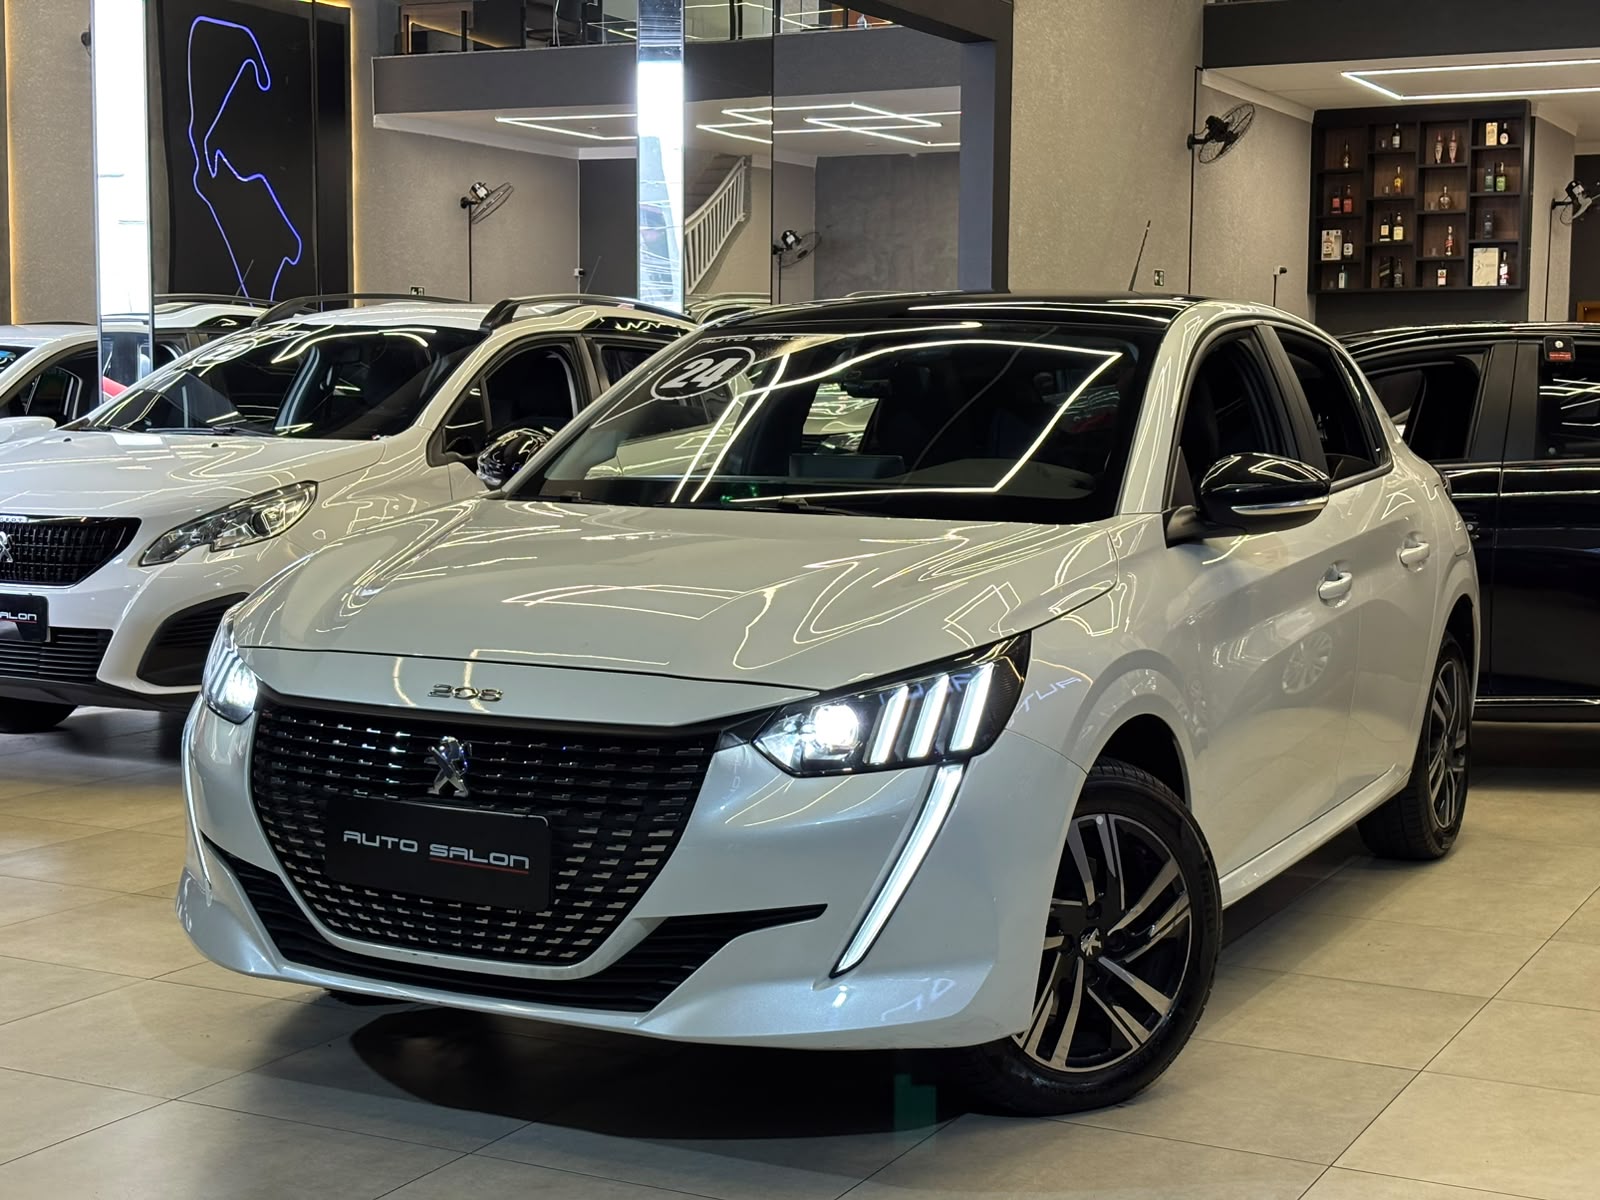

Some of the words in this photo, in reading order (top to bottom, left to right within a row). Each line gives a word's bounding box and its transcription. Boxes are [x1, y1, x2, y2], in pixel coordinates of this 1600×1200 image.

[699, 336, 748, 344] AUTO
[659, 357, 744, 389] 24
[0, 611, 38, 621] ALON
[427, 683, 504, 702] 208
[343, 830, 418, 853] AUTO
[429, 843, 530, 869] SALON
